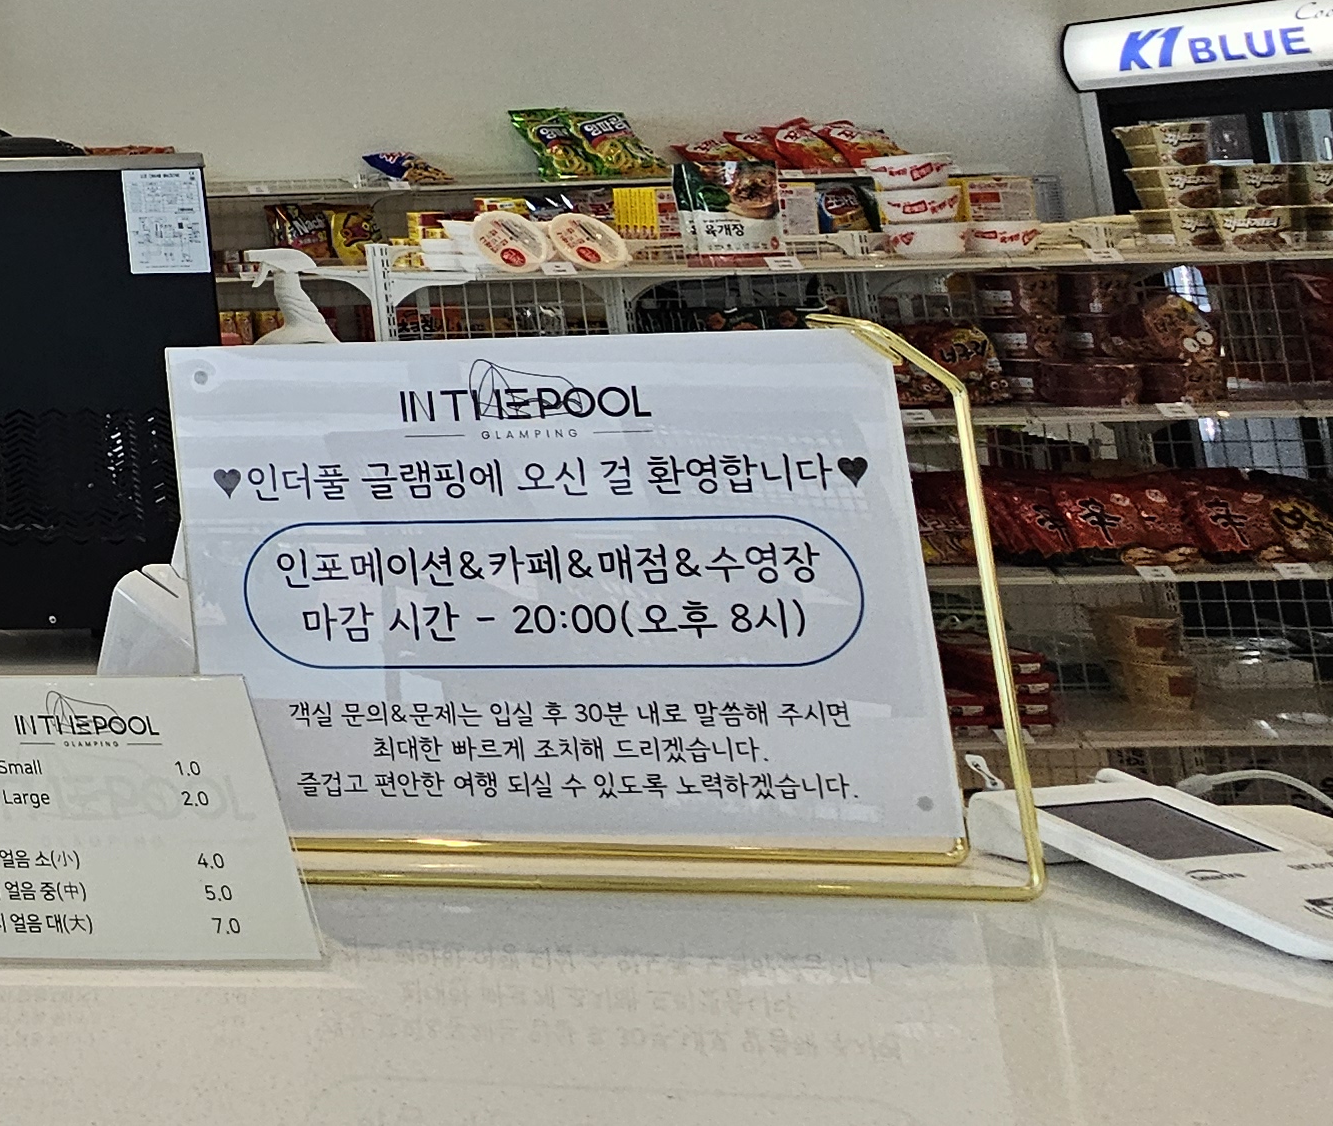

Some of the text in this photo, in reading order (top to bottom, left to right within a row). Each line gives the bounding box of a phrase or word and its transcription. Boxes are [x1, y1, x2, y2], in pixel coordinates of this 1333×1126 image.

[1188, 27, 1312, 64] BLUE
[705, 223, 745, 237] 육개장
[481, 428, 579, 441] GLAMPING
[248, 453, 832, 501] 인더풀 글램핑에 오신 걸 환영합니다
[277, 542, 820, 588] 인포메이션&카페&매점&수영장
[303, 602, 374, 642] 마감
[389, 601, 459, 641] 시간
[513, 600, 718, 639] 20:00(오후
[731, 598, 805, 638] 8시)
[289, 701, 850, 727] 객실 문의&문제는 입실 후 30분 내로 말씀해 주시면
[374, 736, 768, 763] 최대한 빠르게 조치해 드리겠습니다.
[175, 761, 200, 776] 1.0
[297, 771, 858, 799] 즐겁고 편안한 여행 되실 수 있도록 노력하겠습니다.
[3, 790, 50, 808] Large
[181, 791, 208, 806] 2.0
[0, 850, 30, 868] 얼음
[35, 850, 80, 870] 소(小)
[198, 853, 224, 869] 4.0
[5, 881, 36, 900] 얼음
[40, 882, 86, 901] 중(中)
[205, 885, 232, 901] 5.0
[10, 914, 42, 933] 얼음
[46, 914, 92, 934] 대(大)
[212, 918, 240, 934] 7.0
